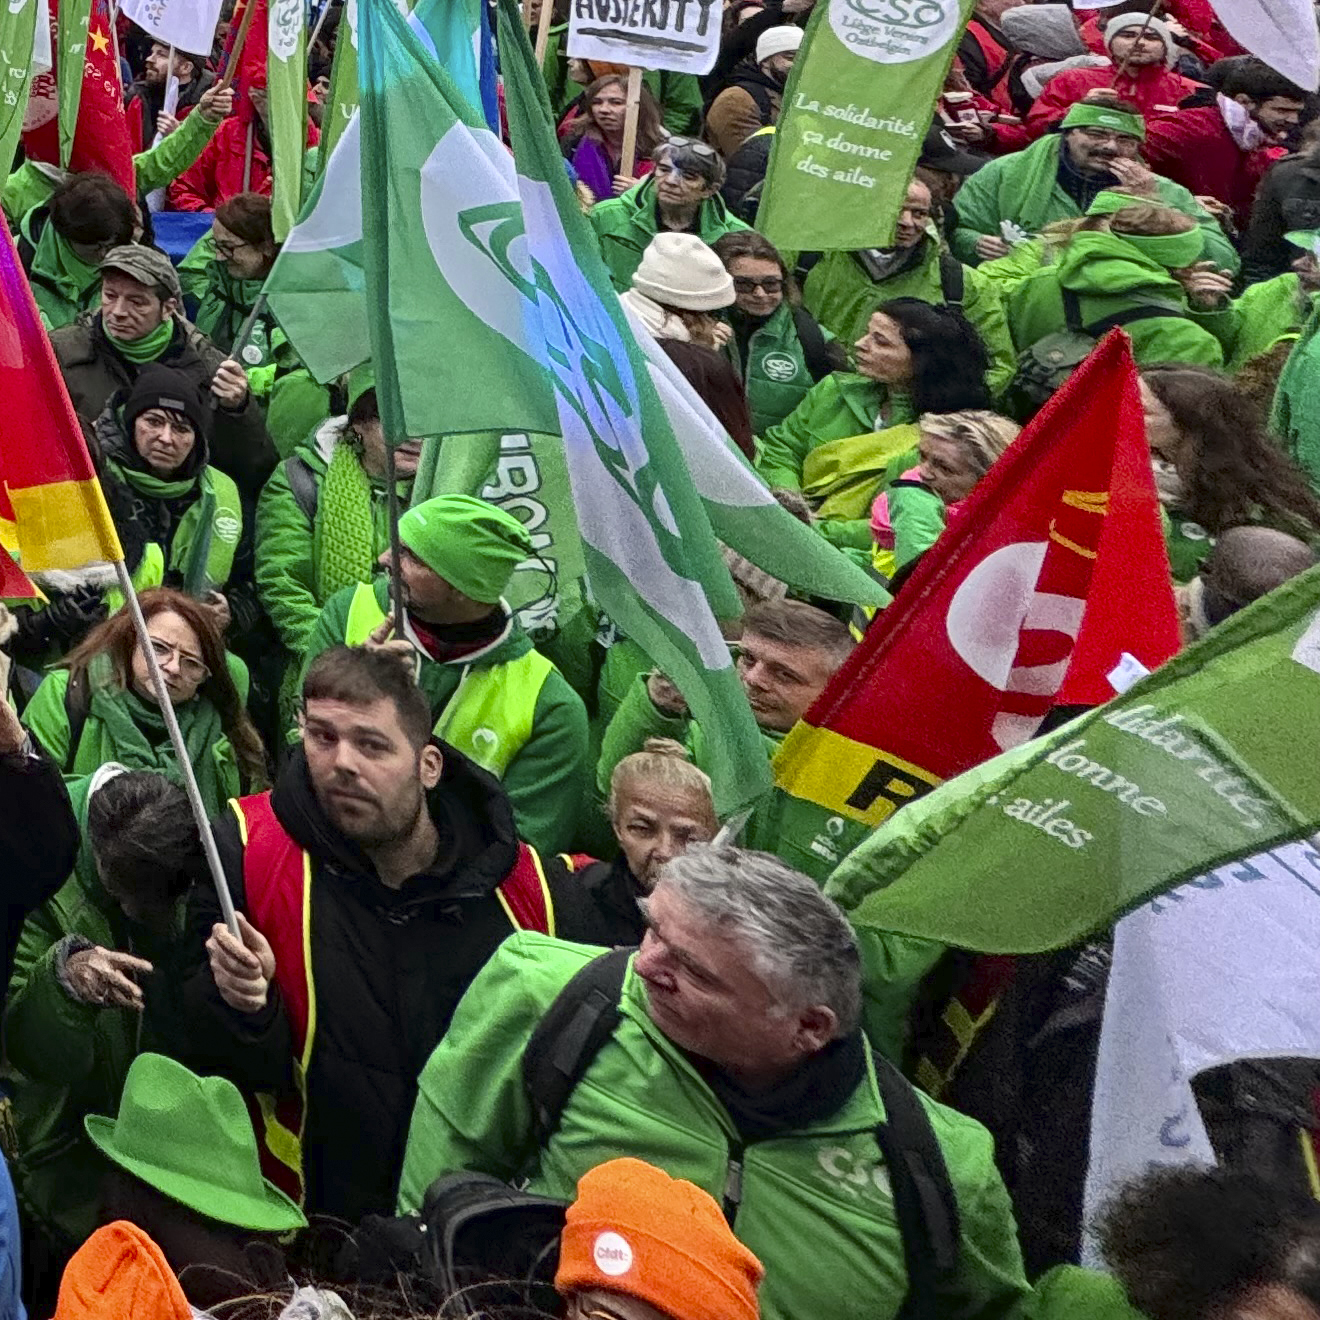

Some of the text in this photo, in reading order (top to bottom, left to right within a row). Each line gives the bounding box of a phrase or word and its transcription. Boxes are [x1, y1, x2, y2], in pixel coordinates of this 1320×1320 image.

[795, 91, 919, 140] La solidarité,
[801, 126, 893, 162] ça donne
[796, 154, 877, 189] des ailes
[1009, 794, 1094, 850] ailes
